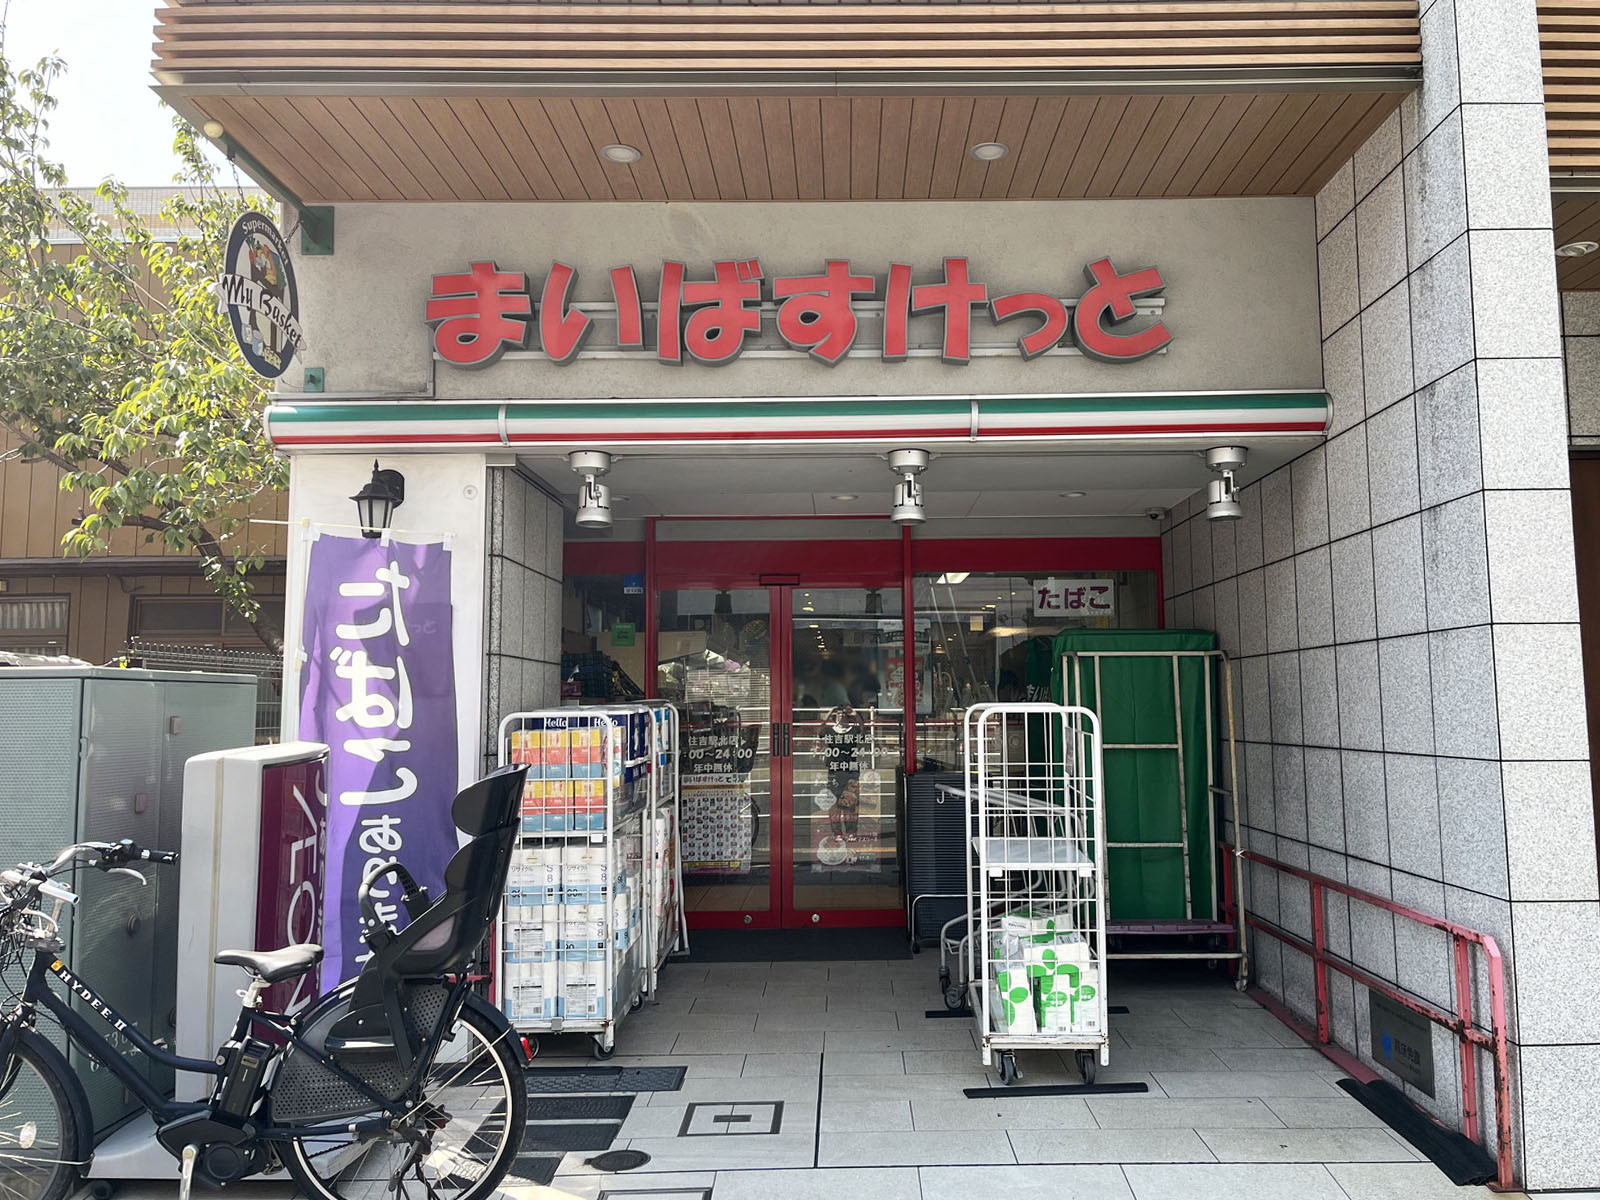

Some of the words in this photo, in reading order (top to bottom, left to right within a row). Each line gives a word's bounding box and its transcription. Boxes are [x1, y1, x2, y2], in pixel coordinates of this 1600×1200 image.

[241, 219, 289, 266] Supermarket
[222, 275, 253, 311] My
[259, 290, 302, 347] Basket
[426, 257, 1175, 368] まいばすけっと
[1037, 586, 1111, 610] たばこ
[545, 717, 567, 728] Hello
[594, 717, 618, 728] Heo
[688, 735, 739, 747] 住吉駅北店
[824, 734, 874, 745] 住吉駅北店
[679, 748, 753, 759] :00～24:00
[694, 763, 733, 773] 年中無休
[829, 761, 869, 771] 年中無休
